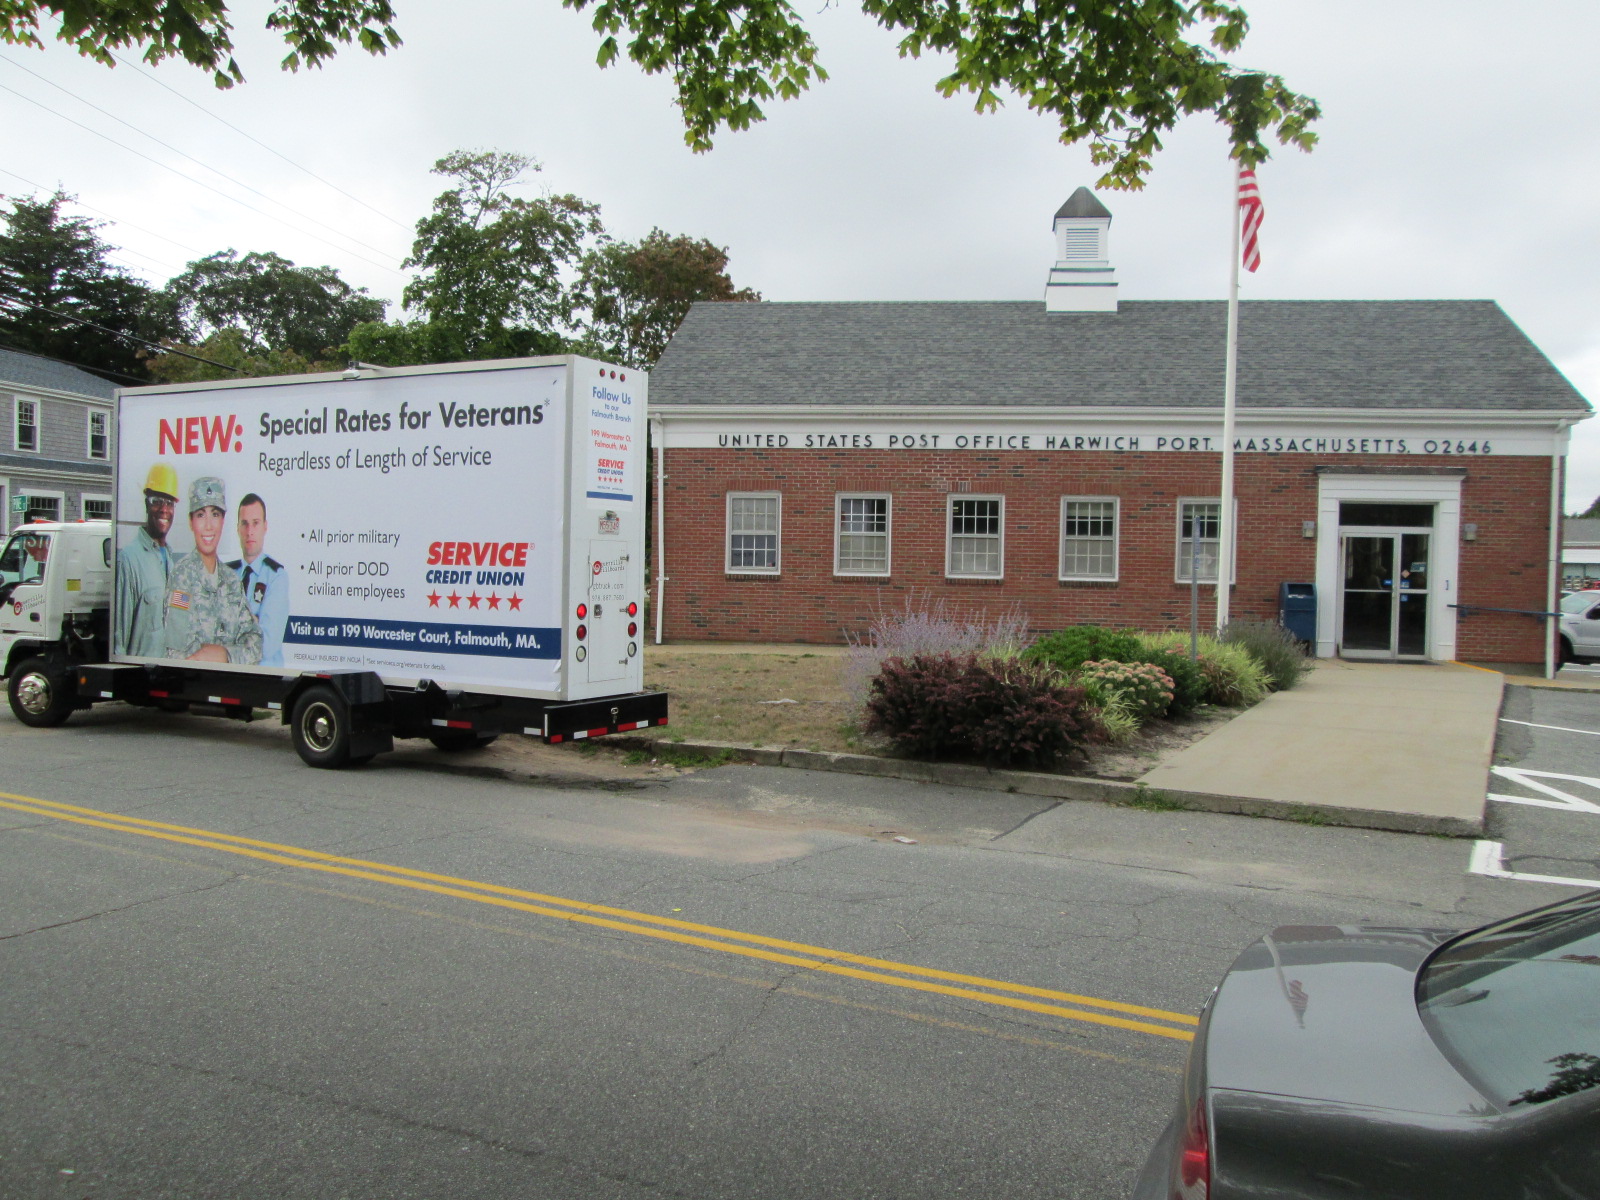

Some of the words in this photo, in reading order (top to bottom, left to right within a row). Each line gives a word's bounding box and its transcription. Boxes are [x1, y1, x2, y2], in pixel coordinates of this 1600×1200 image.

[592, 385, 619, 403] Follow
[621, 393, 632, 405] Us
[591, 409, 614, 420] Falmouth
[615, 414, 632, 423] Branch
[611, 404, 620, 412] our
[259, 407, 328, 444] Special
[335, 408, 391, 433] Rates
[399, 402, 432, 430] for
[158, 414, 243, 455] NEW:
[591, 429, 600, 437] 199
[601, 430, 625, 441] Worcester
[718, 434, 789, 447] UNITED
[805, 434, 873, 448] STATES
[889, 434, 940, 448] POST
[955, 435, 1031, 449] OFFICE
[1046, 436, 1139, 450] HARWICH
[1157, 437, 1214, 451] PORT.
[1424, 439, 1492, 454] 02646
[619, 443, 628, 451] MA
[259, 450, 331, 477] Regardless
[336, 448, 352, 469] of
[355, 446, 406, 474] Length
[412, 445, 430, 467] of
[433, 446, 492, 467] Service
[598, 458, 625, 470] SERVICE
[597, 467, 610, 475] CREDIT
[308, 528, 324, 544] All
[327, 529, 353, 547] prior
[358, 529, 401, 549] military
[426, 541, 529, 567] SERVICE
[308, 561, 324, 576] All
[326, 561, 353, 578] prior
[357, 561, 389, 577] DOD
[426, 569, 472, 585] CREDIT
[476, 570, 525, 587] UNION
[308, 582, 343, 596] civilian
[346, 584, 406, 602] employees
[290, 621, 311, 636] Visit
[314, 626, 325, 637] us
[327, 623, 339, 637] at
[342, 624, 360, 638] 199
[363, 625, 416, 643] Worcester
[419, 628, 452, 646] Court,
[455, 630, 512, 650] Falmouth,
[515, 634, 541, 650] MA.
[294, 653, 318, 661] FEDERALLY
